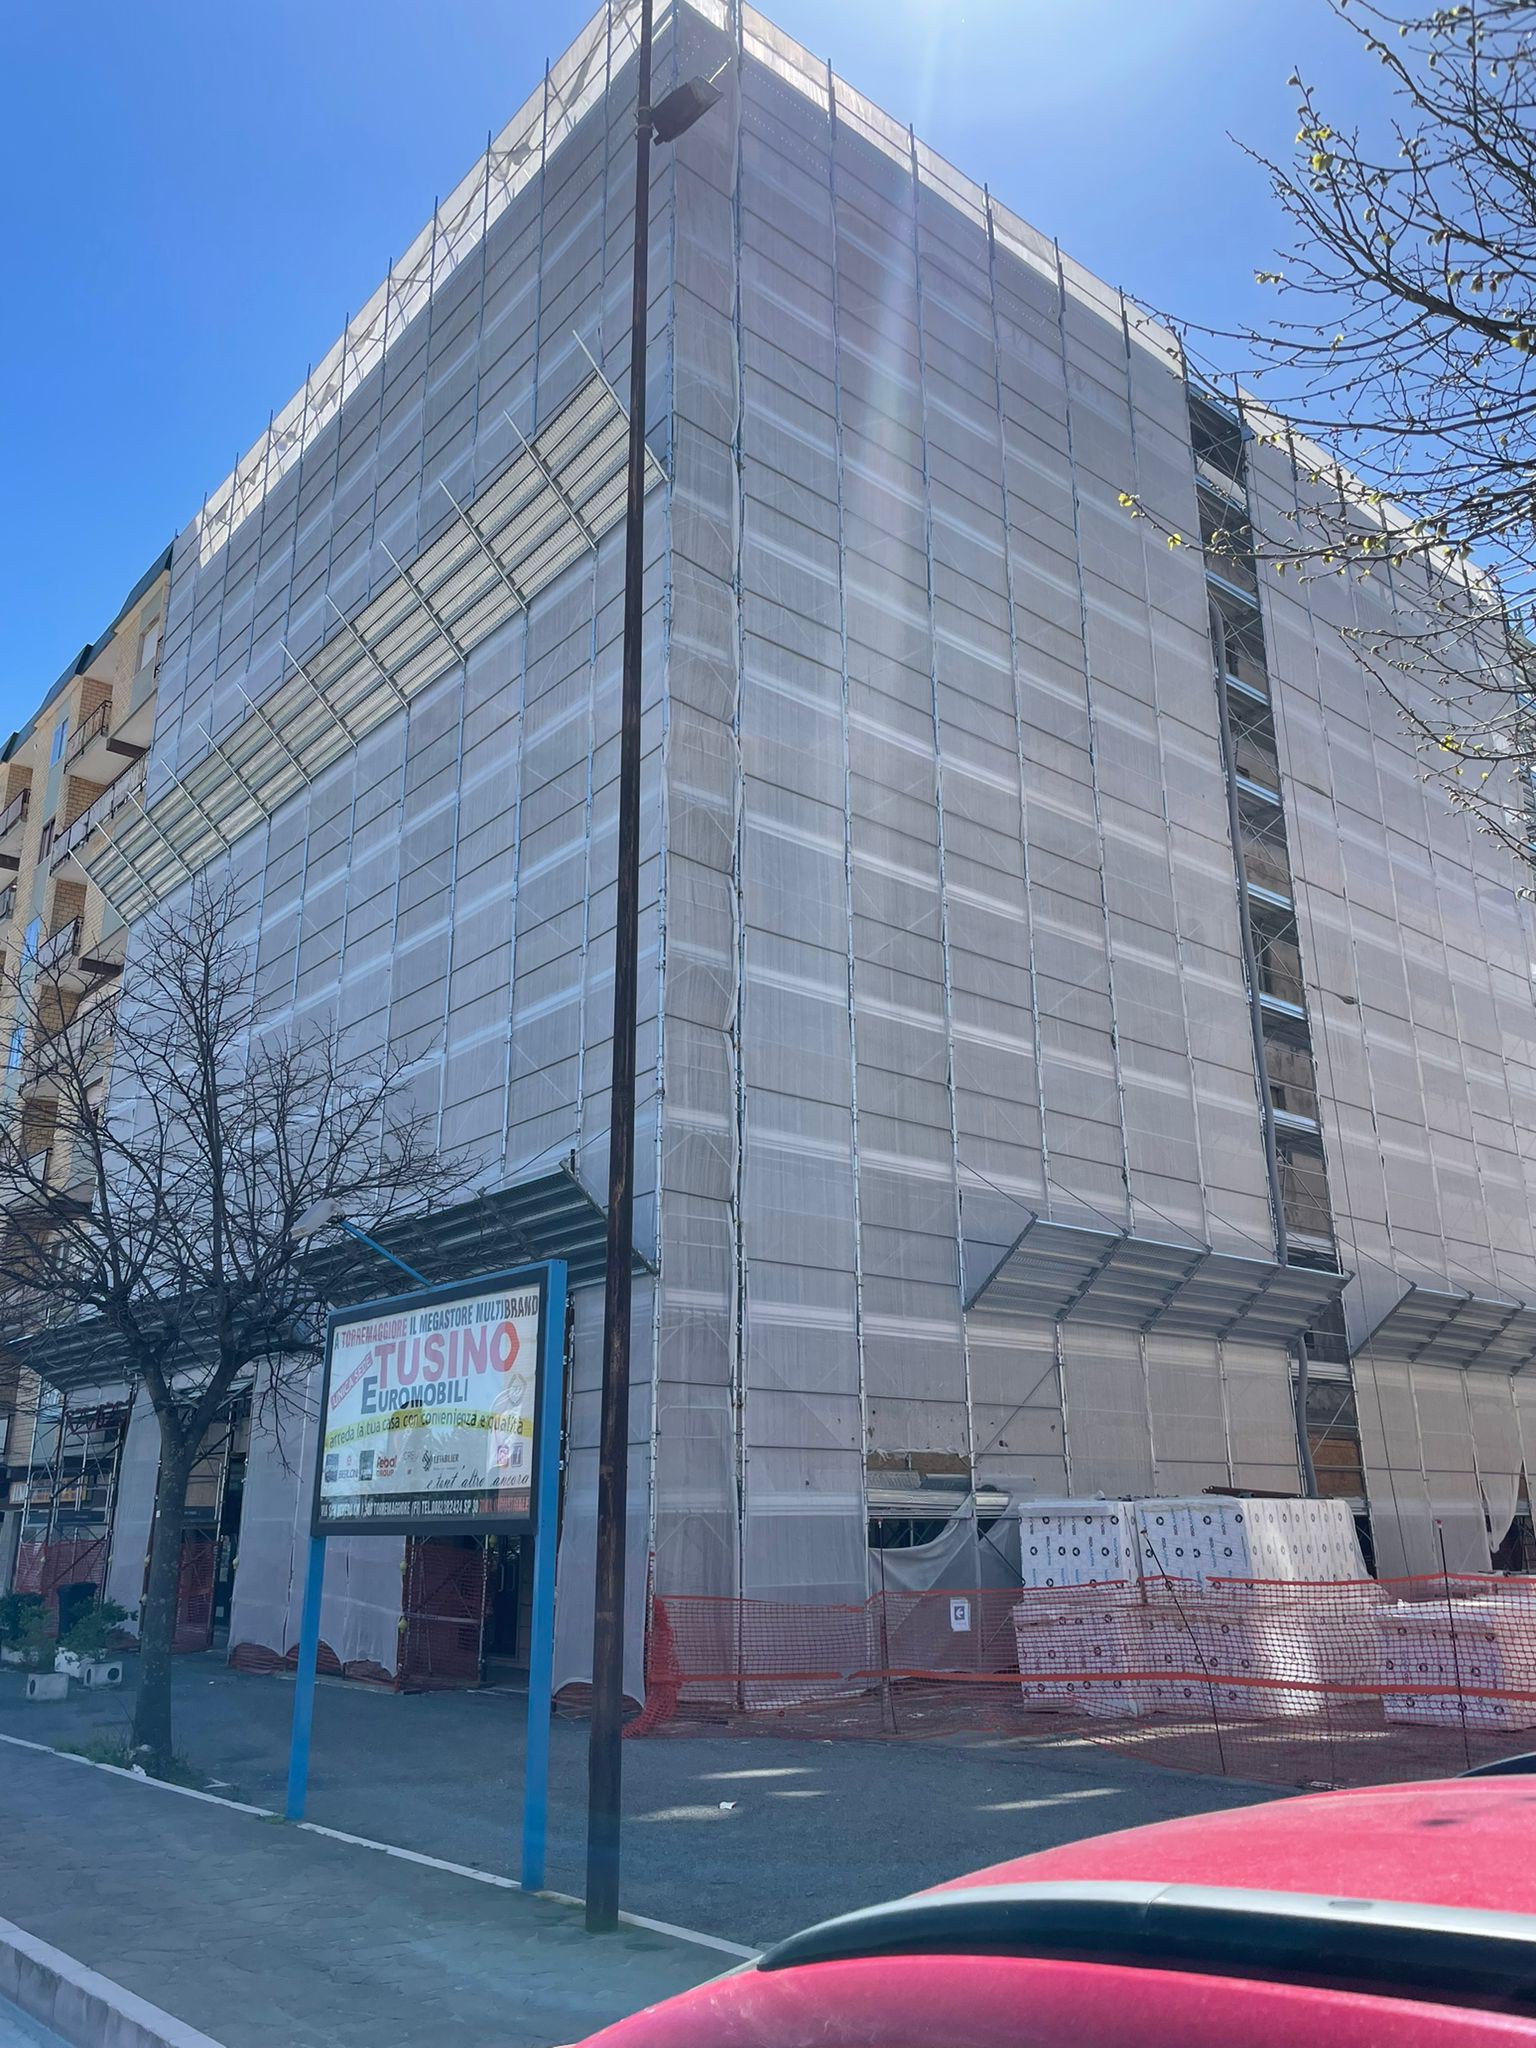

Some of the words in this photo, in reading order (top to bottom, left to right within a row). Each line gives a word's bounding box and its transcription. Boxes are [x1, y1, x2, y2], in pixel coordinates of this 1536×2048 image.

[335, 1332, 340, 1350] A
[341, 1318, 408, 1348] TORREMAGGIORE
[410, 1316, 417, 1336] IL
[419, 1305, 474, 1334] MEGASTORE
[476, 1295, 539, 1323] MULTIBRAND
[374, 1320, 520, 1390] TUSINO
[329, 1426, 355, 1449] arreda
[356, 1424, 364, 1439] la
[366, 1418, 381, 1435] tua
[382, 1414, 400, 1431] casa
[403, 1413, 419, 1426] con
[421, 1408, 477, 1427] convenienza
[480, 1415, 486, 1428] e
[490, 1474, 530, 1488] ancora
